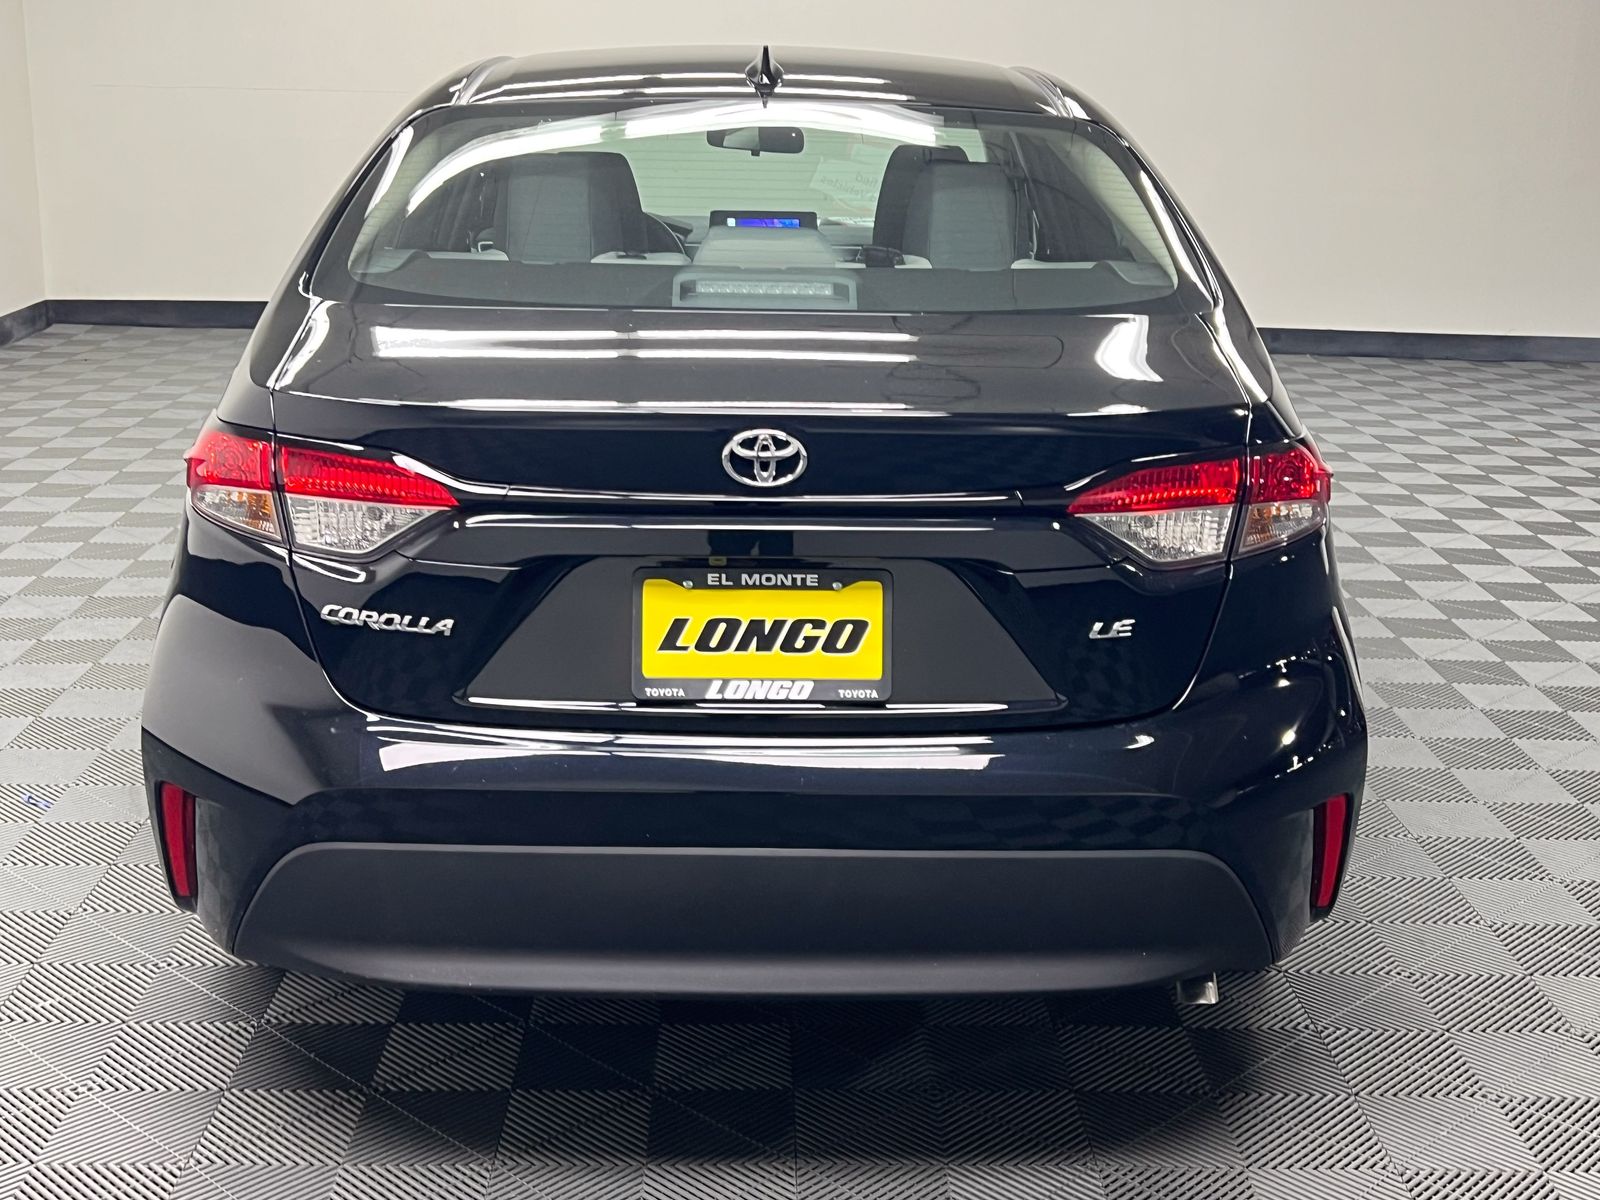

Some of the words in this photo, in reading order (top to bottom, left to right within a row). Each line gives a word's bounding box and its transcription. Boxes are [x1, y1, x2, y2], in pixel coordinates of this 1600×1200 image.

[707, 573, 733, 586] EL
[741, 574, 819, 586] MONTE
[321, 604, 455, 636] COROLLA
[1089, 619, 1136, 639] LE
[657, 617, 869, 654] LONGO
[645, 687, 685, 697] TOYOTA
[705, 680, 814, 700] LONGO
[838, 689, 878, 699] TOYOTA
